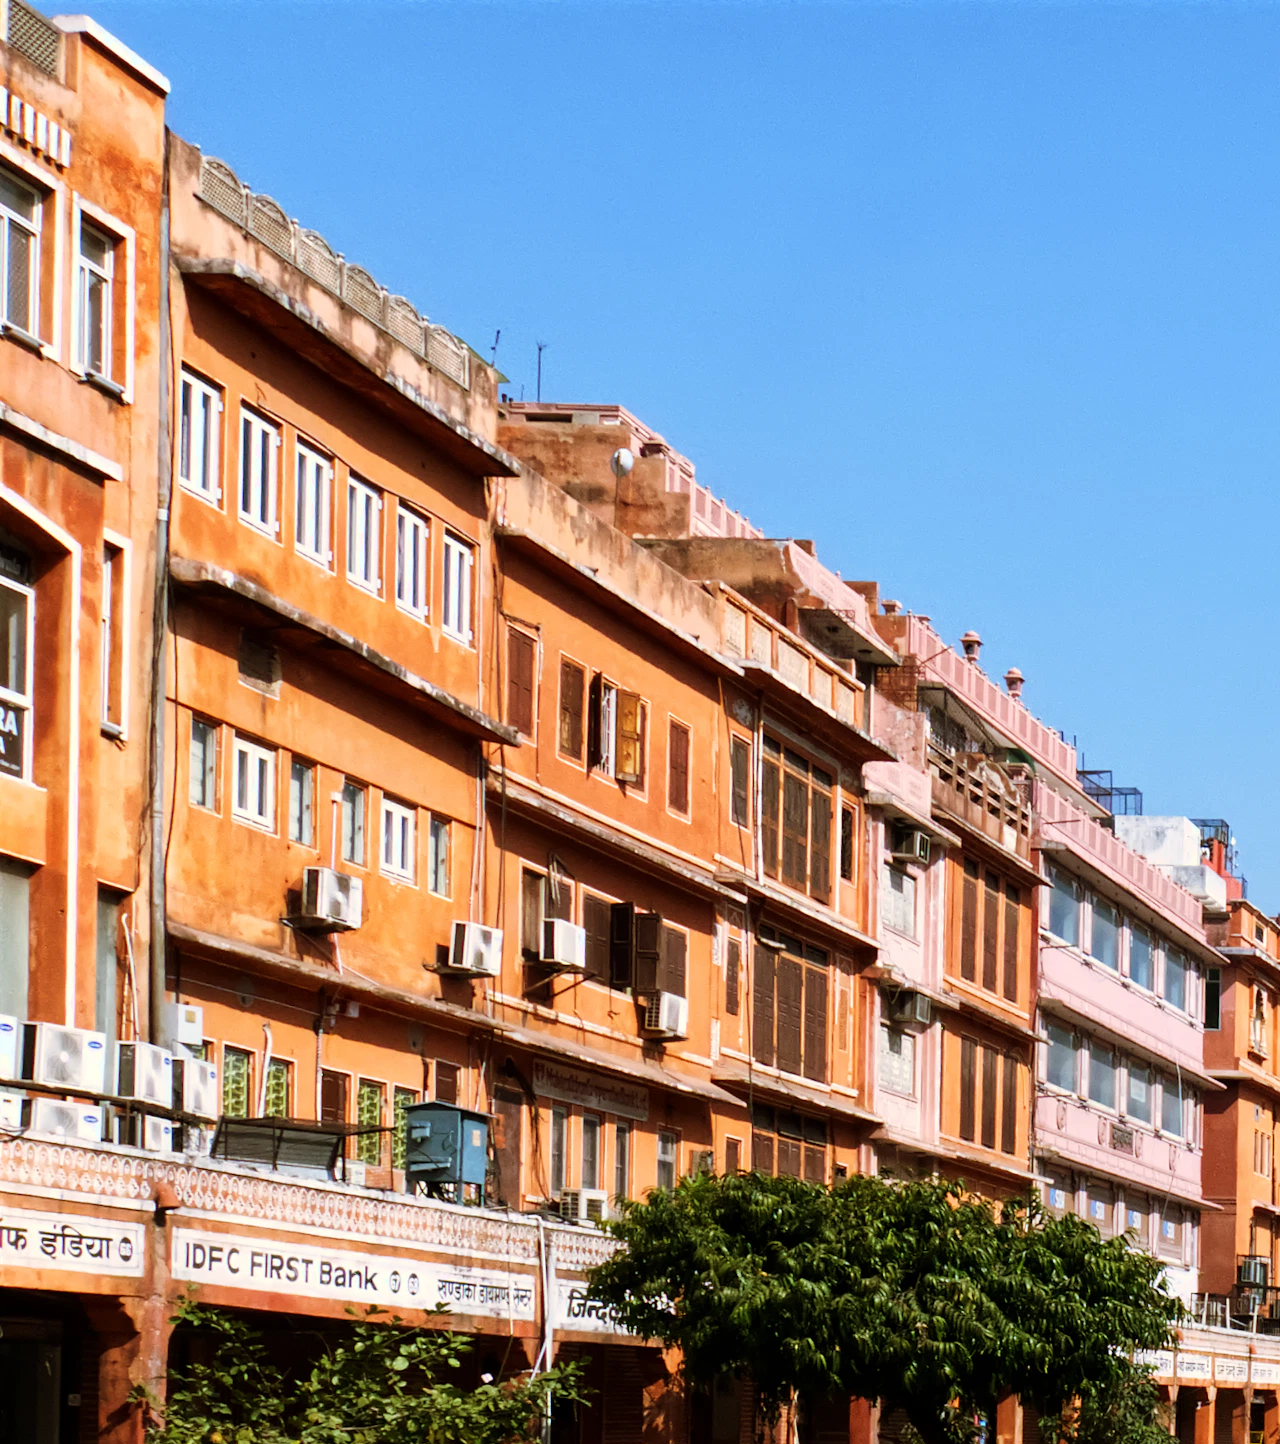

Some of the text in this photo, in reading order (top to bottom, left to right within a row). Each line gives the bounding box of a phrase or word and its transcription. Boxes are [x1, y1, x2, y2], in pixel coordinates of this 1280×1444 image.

[38, 1223, 113, 1260] इंडिया
[185, 1242, 240, 1275] IDFC
[250, 1251, 313, 1283] FIRST
[319, 1261, 378, 1291] Bank
